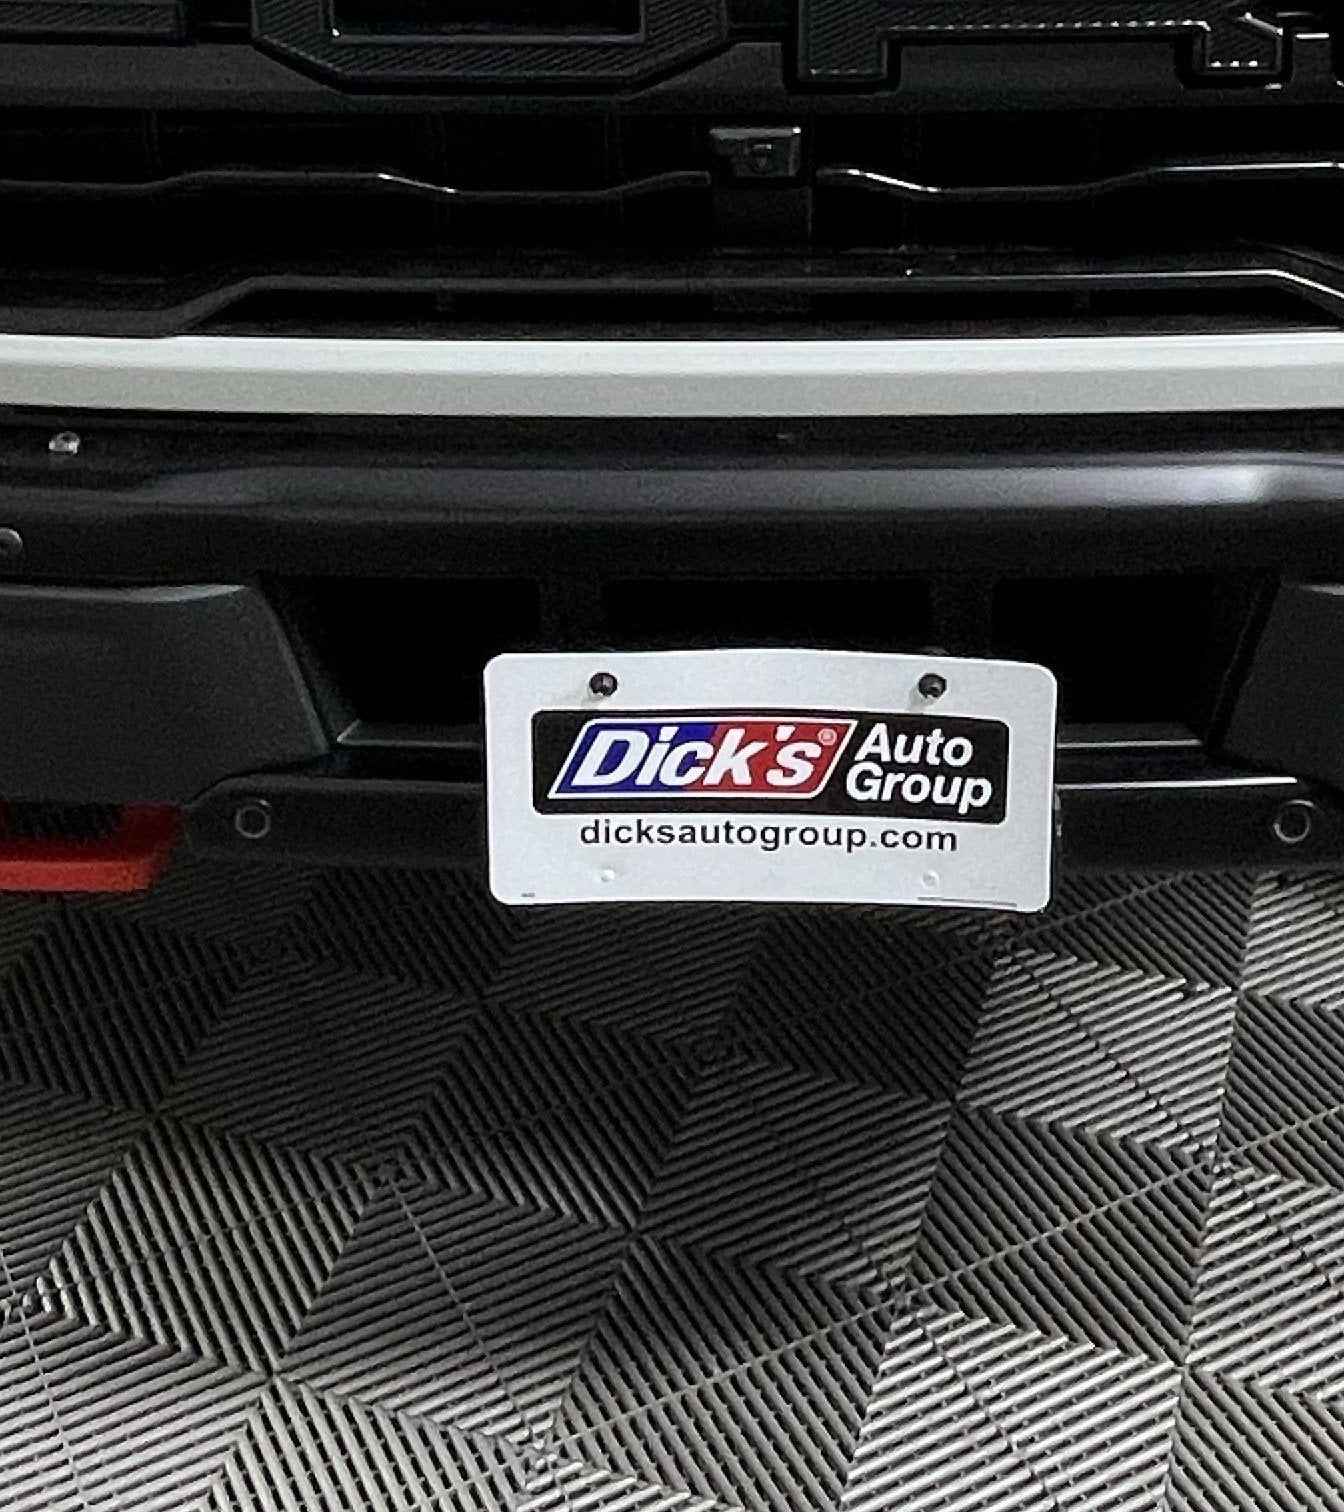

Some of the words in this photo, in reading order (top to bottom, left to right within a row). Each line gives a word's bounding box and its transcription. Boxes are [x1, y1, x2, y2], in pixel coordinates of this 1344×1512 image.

[855, 723, 973, 767] Auto
[845, 763, 993, 814] Group
[579, 819, 958, 853] dicksautogroup.com
